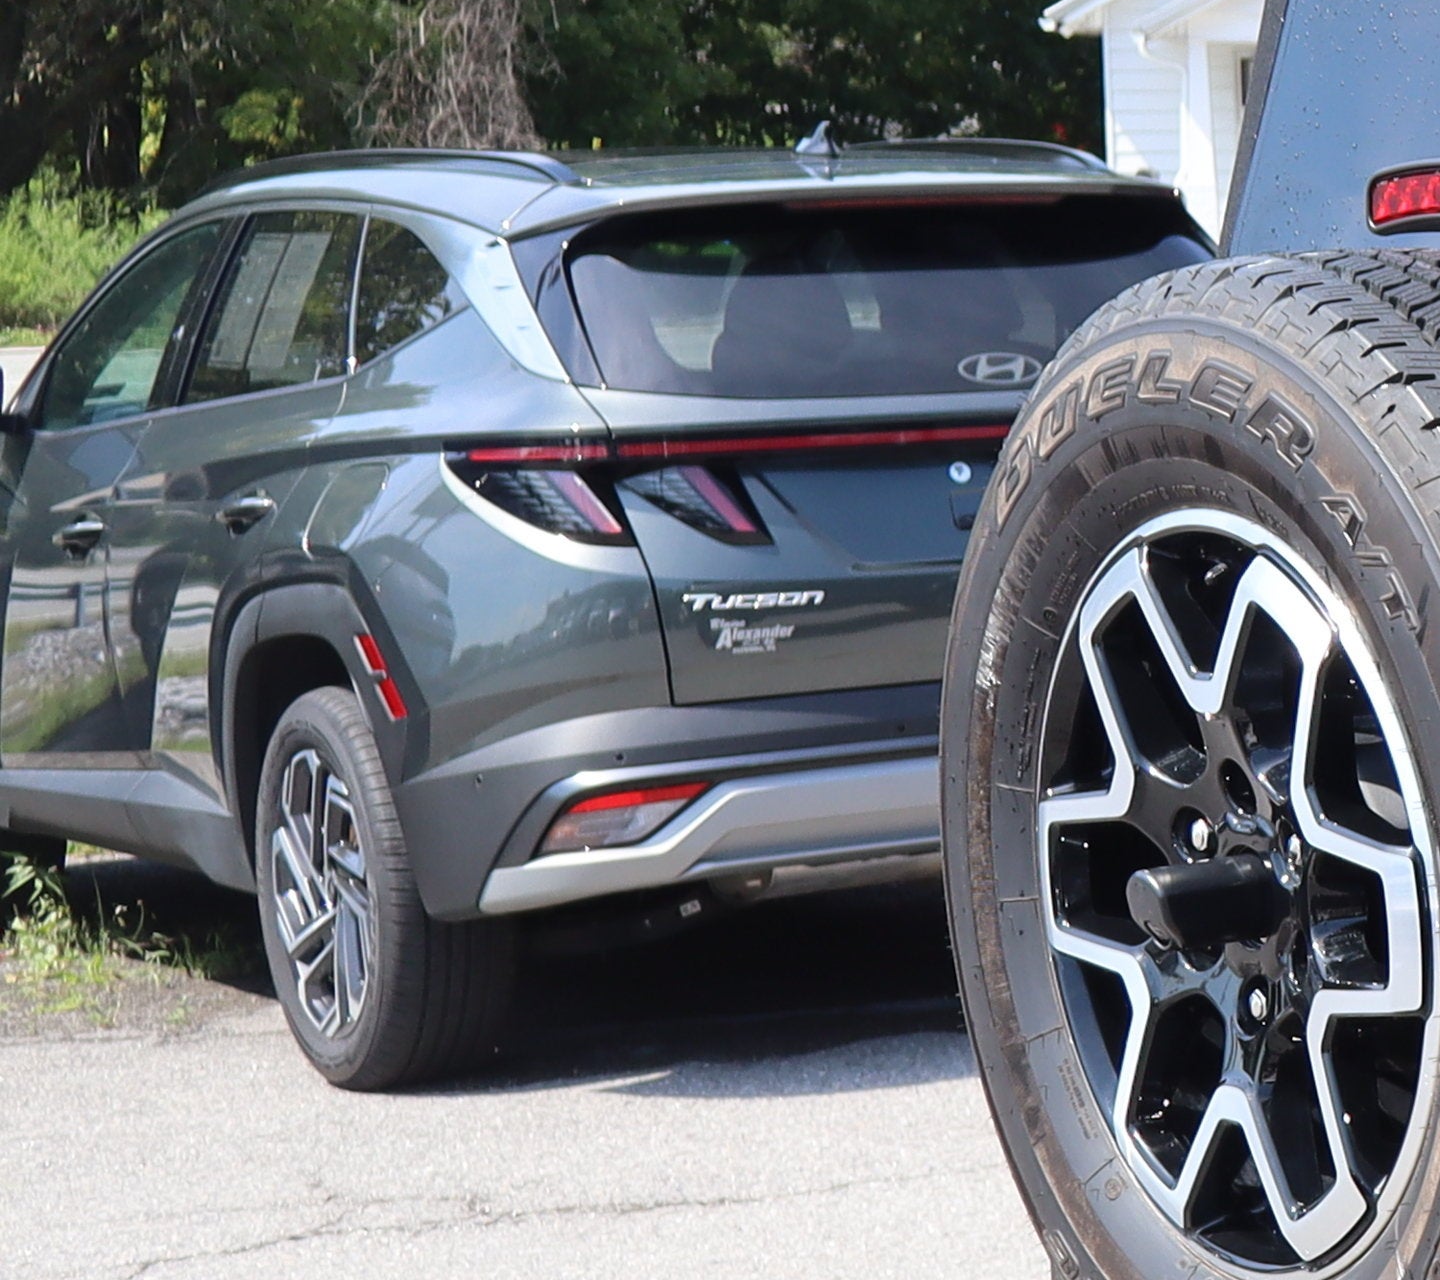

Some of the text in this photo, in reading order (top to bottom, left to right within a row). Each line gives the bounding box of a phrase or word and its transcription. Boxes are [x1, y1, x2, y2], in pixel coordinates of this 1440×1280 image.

[995, 349, 1424, 634] DUELER A/T
[715, 623, 795, 650] Alexander
